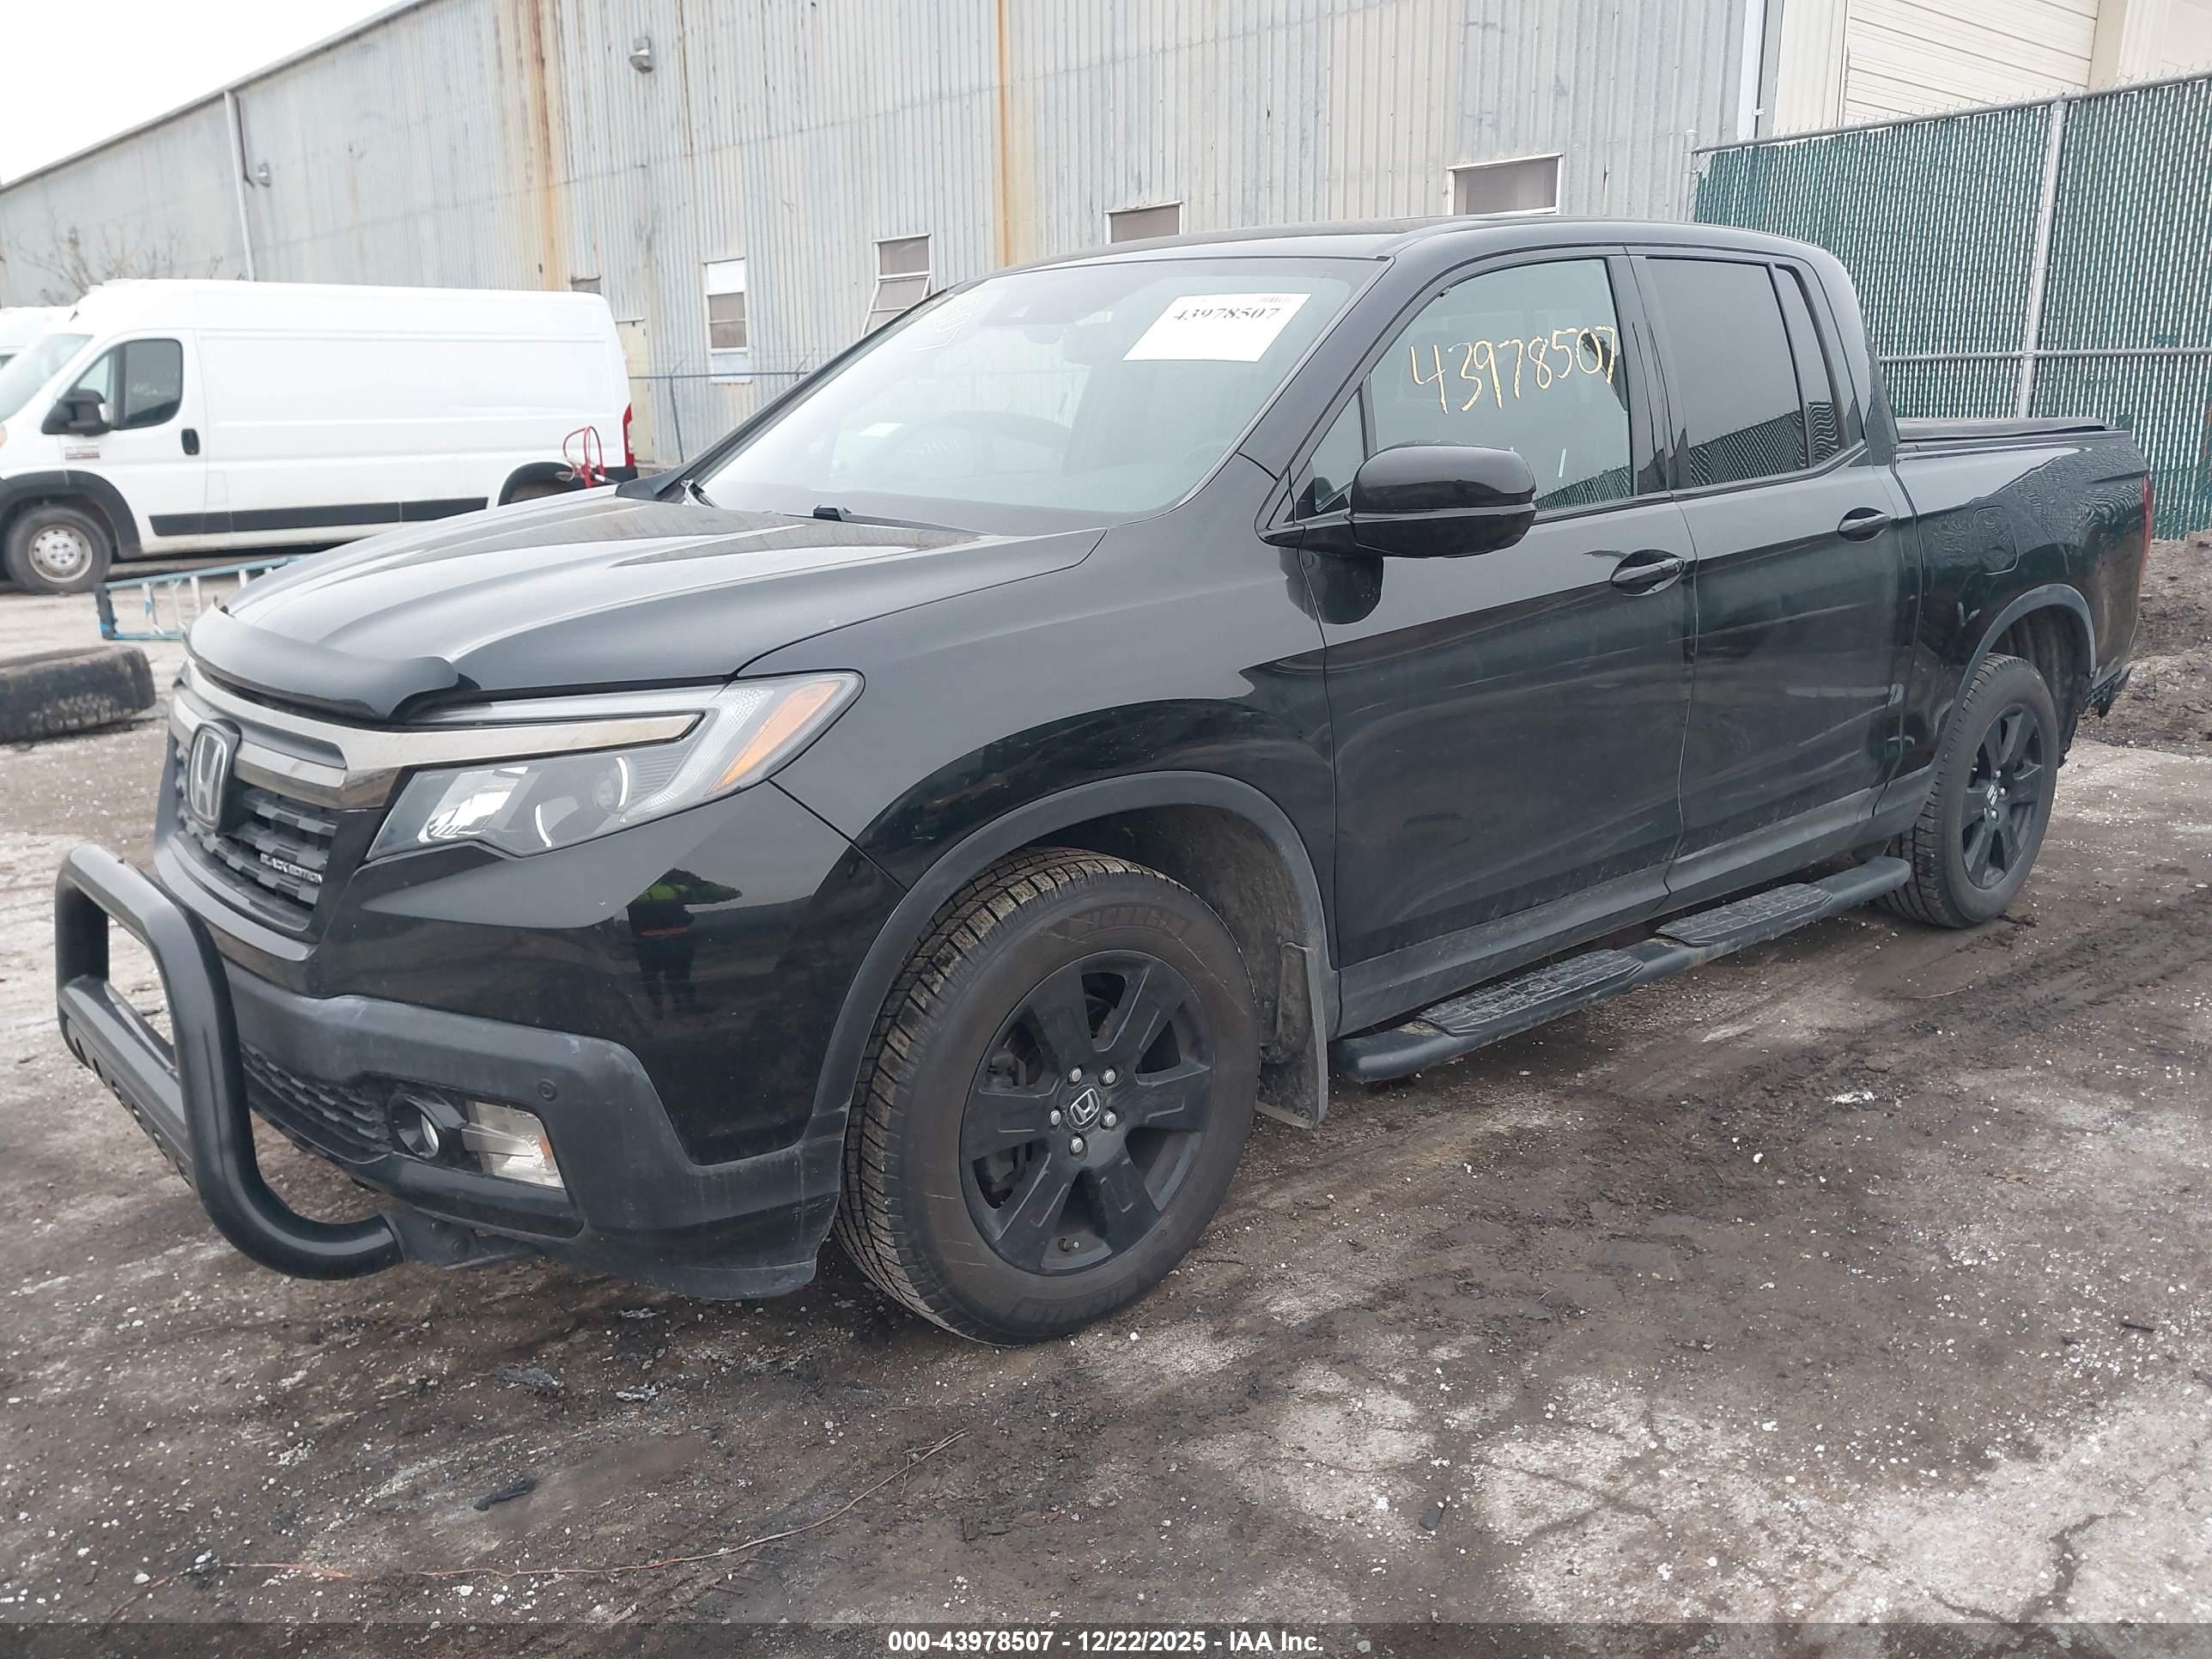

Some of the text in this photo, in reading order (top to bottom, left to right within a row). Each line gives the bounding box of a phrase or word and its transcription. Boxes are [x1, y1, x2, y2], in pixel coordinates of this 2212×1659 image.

[1173, 307, 1282, 321] 43978507
[1409, 325, 1616, 414] 43978507
[259, 853, 289, 873] BLACK
